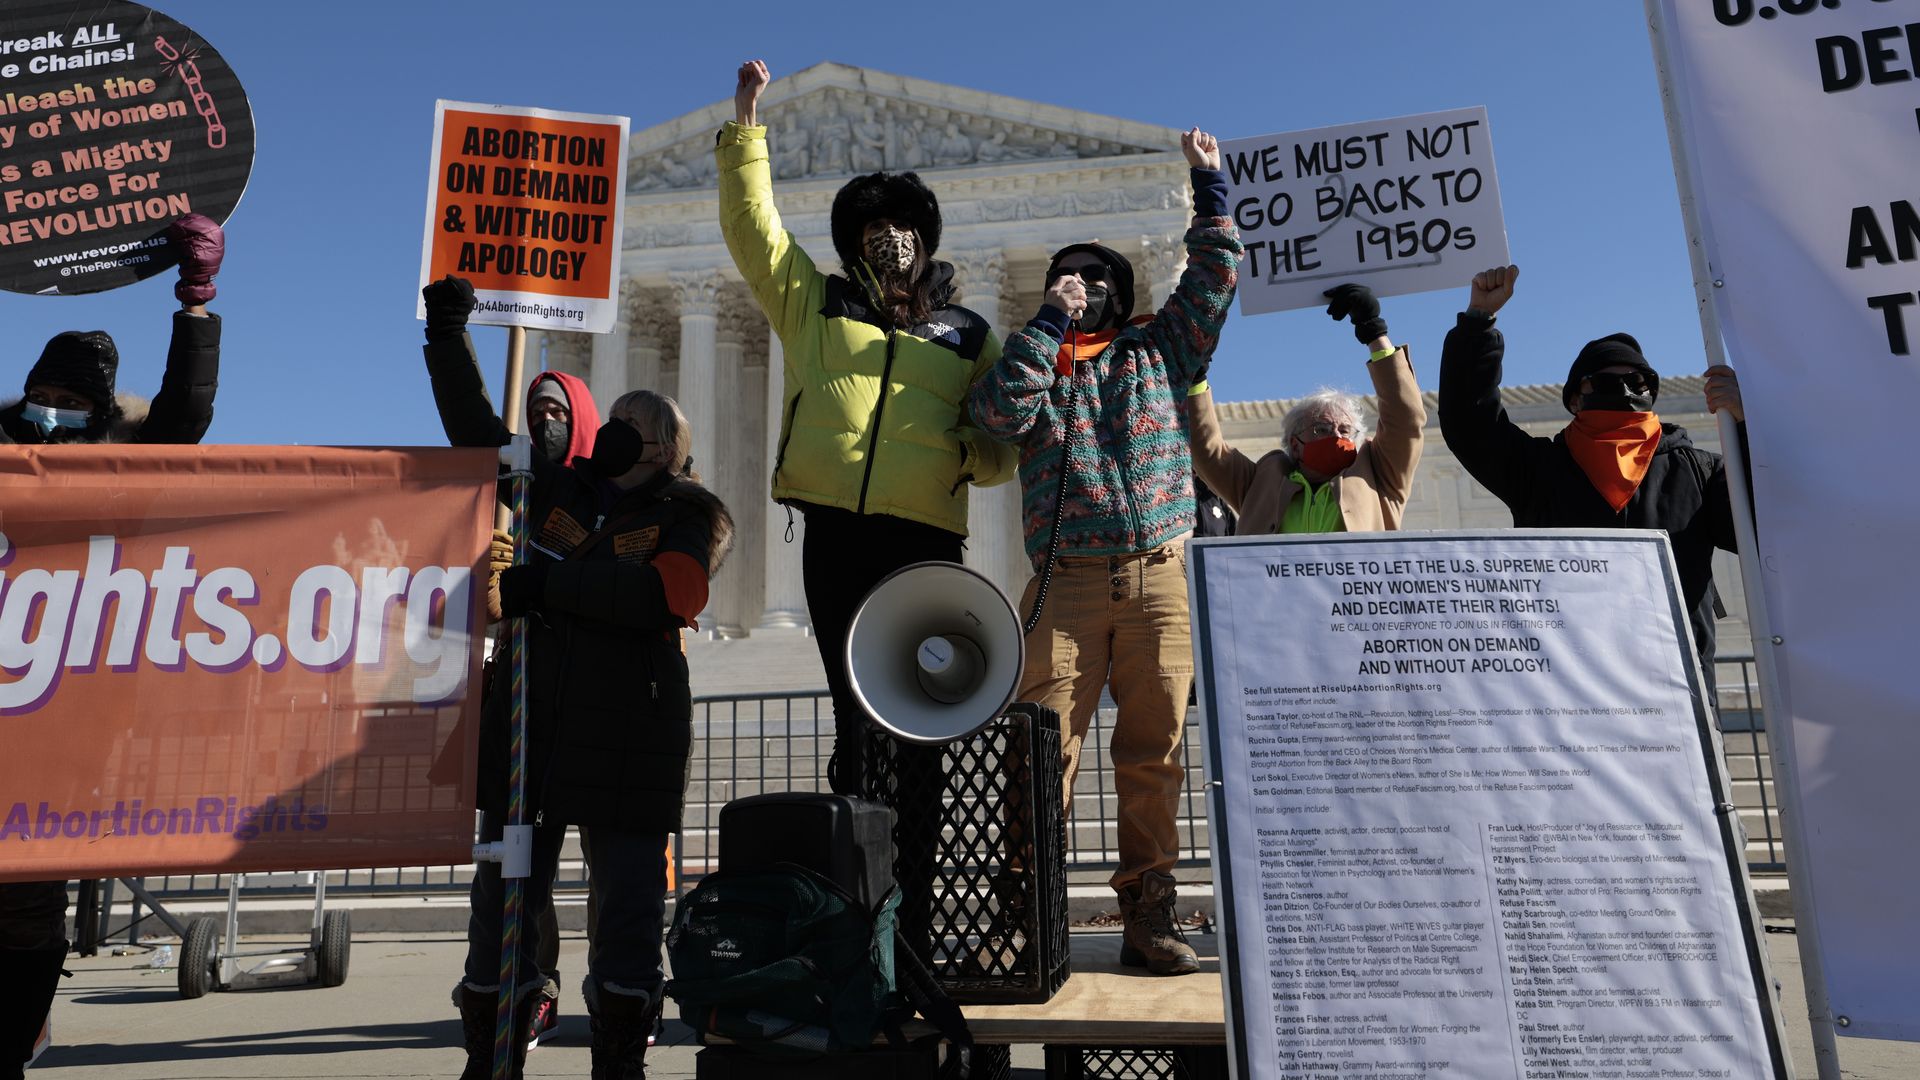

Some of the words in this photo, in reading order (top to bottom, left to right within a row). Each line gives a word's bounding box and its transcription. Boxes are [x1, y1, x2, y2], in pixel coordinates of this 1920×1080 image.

[72, 23, 121, 46] ALL
[29, 43, 135, 74] Chains!
[103, 77, 156, 100] the
[28, 114, 63, 139] of
[71, 99, 188, 132] Women
[461, 126, 606, 167] ABORTION
[1226, 145, 1283, 186] WE
[1295, 132, 1389, 179] MUST
[1406, 120, 1480, 162] NOT
[31, 159, 53, 178] a
[61, 139, 173, 172] Mighty
[4, 183, 100, 214] Force
[108, 172, 161, 196] For
[446, 162, 485, 195] ON
[492, 166, 610, 205] DEMAND
[1234, 192, 1293, 232] GO
[1315, 175, 1425, 222] BACK
[1432, 168, 1482, 207] TO
[443, 204, 466, 233] &
[475, 204, 607, 244] WITHOUT
[33, 236, 168, 268] www.revcom.us
[1243, 234, 1322, 278] THE
[1356, 218, 1477, 263] 1950s
[60, 253, 151, 277] @TheRevcoms
[457, 242, 587, 281] APOLOGY
[1265, 564, 1290, 577] WE
[1295, 562, 1355, 576] REFUSE
[1359, 561, 1379, 574] TO
[1384, 561, 1411, 574] LET
[1416, 560, 1446, 573] THE
[1450, 560, 1479, 573] U.S.
[1484, 559, 1556, 573] SUPREME
[1559, 559, 1608, 573] COURT
[1343, 582, 1383, 595] DENY
[1387, 580, 1460, 594] WOMEN'S
[1465, 579, 1541, 592] HUMANITY
[1332, 602, 1363, 615] AND
[1368, 600, 1446, 614] DECIMATE
[1452, 600, 1495, 613] THEIR
[1499, 599, 1560, 613] RIGHTS!
[1331, 624, 1345, 632] WE
[1347, 623, 1370, 631] CALL
[1372, 622, 1385, 631] ON
[1388, 621, 1436, 630] EVERYONE
[1440, 620, 1452, 629] TO
[1454, 620, 1475, 629] JOIN
[1477, 621, 1488, 630] US
[1502, 620, 1543, 630] FIGHTING
[1363, 639, 1443, 653] ABORTION
[1448, 638, 1470, 652] ON
[1475, 637, 1540, 651] DEMAND
[1359, 661, 1390, 675] AND
[1394, 659, 1465, 673] WITHOUT
[1471, 658, 1551, 672] APOLOGY!
[1244, 687, 1258, 695] See
[1260, 686, 1271, 694] full
[1321, 684, 1441, 692] RiseUp4AbortionRights.org
[1302, 736, 1323, 744] Emmy
[1252, 774, 1266, 782] Lori
[1291, 773, 1323, 781] Executive
[1441, 770, 1447, 778] of
[1335, 786, 1354, 794] Board
[1494, 783, 1518, 791] Refuse
[1519, 783, 1546, 791] Fascism
[1255, 806, 1274, 814] Initial
[1276, 806, 1302, 815] signers
